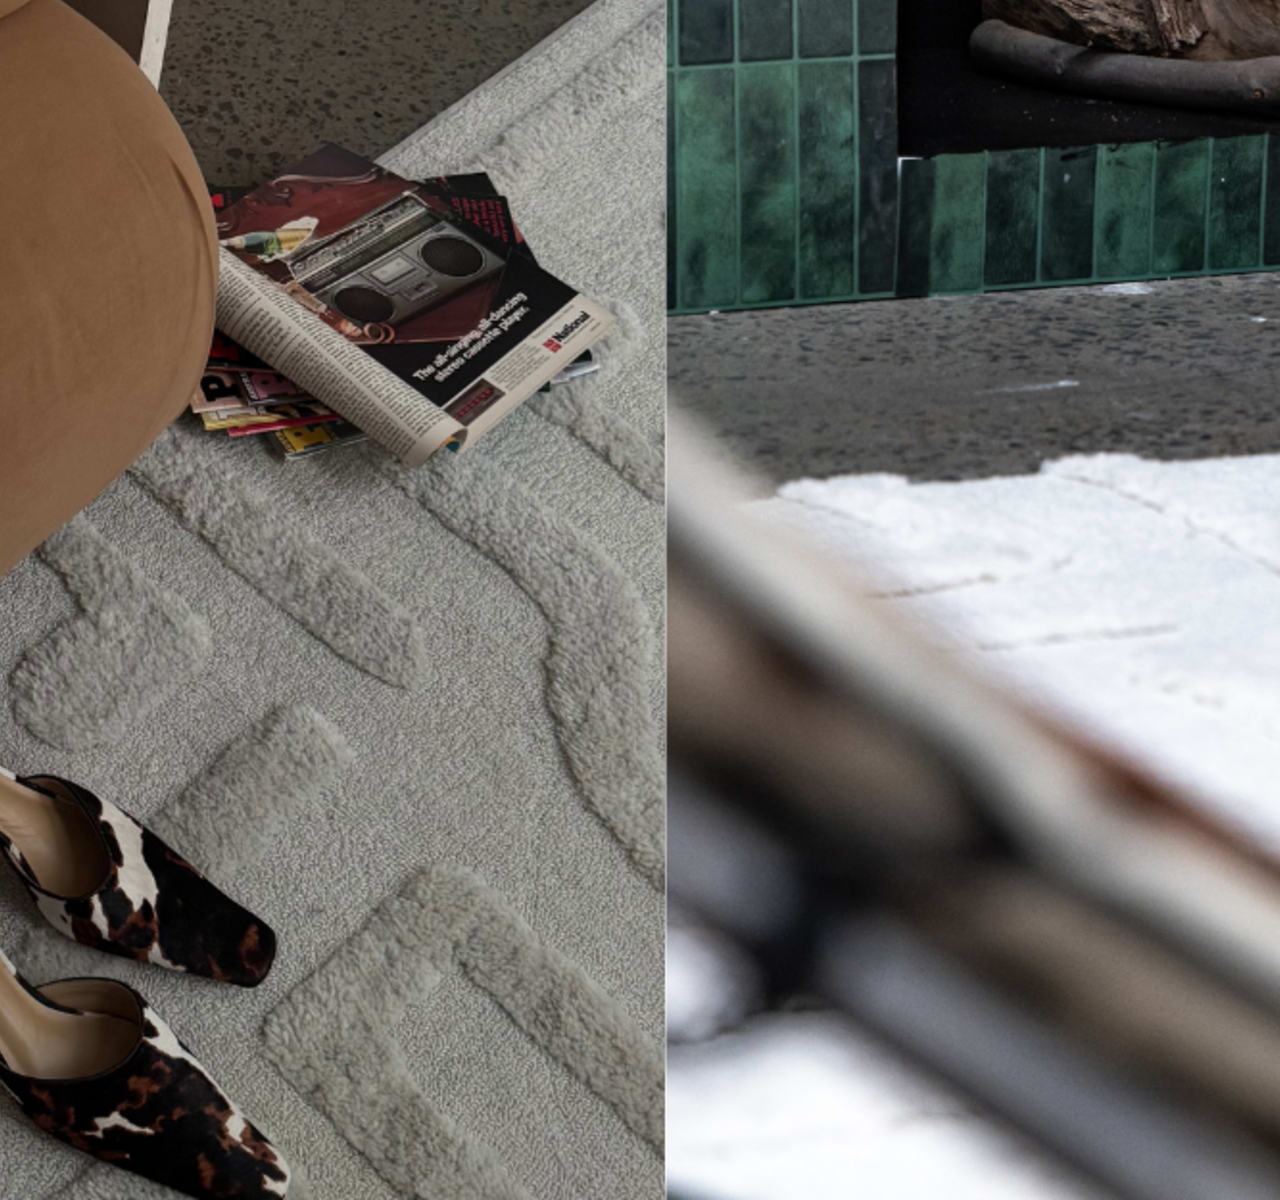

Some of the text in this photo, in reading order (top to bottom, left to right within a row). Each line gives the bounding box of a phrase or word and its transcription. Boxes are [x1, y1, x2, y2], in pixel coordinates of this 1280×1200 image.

[552, 311, 591, 342] National
[412, 364, 436, 381] The
[434, 357, 466, 383] stereo
